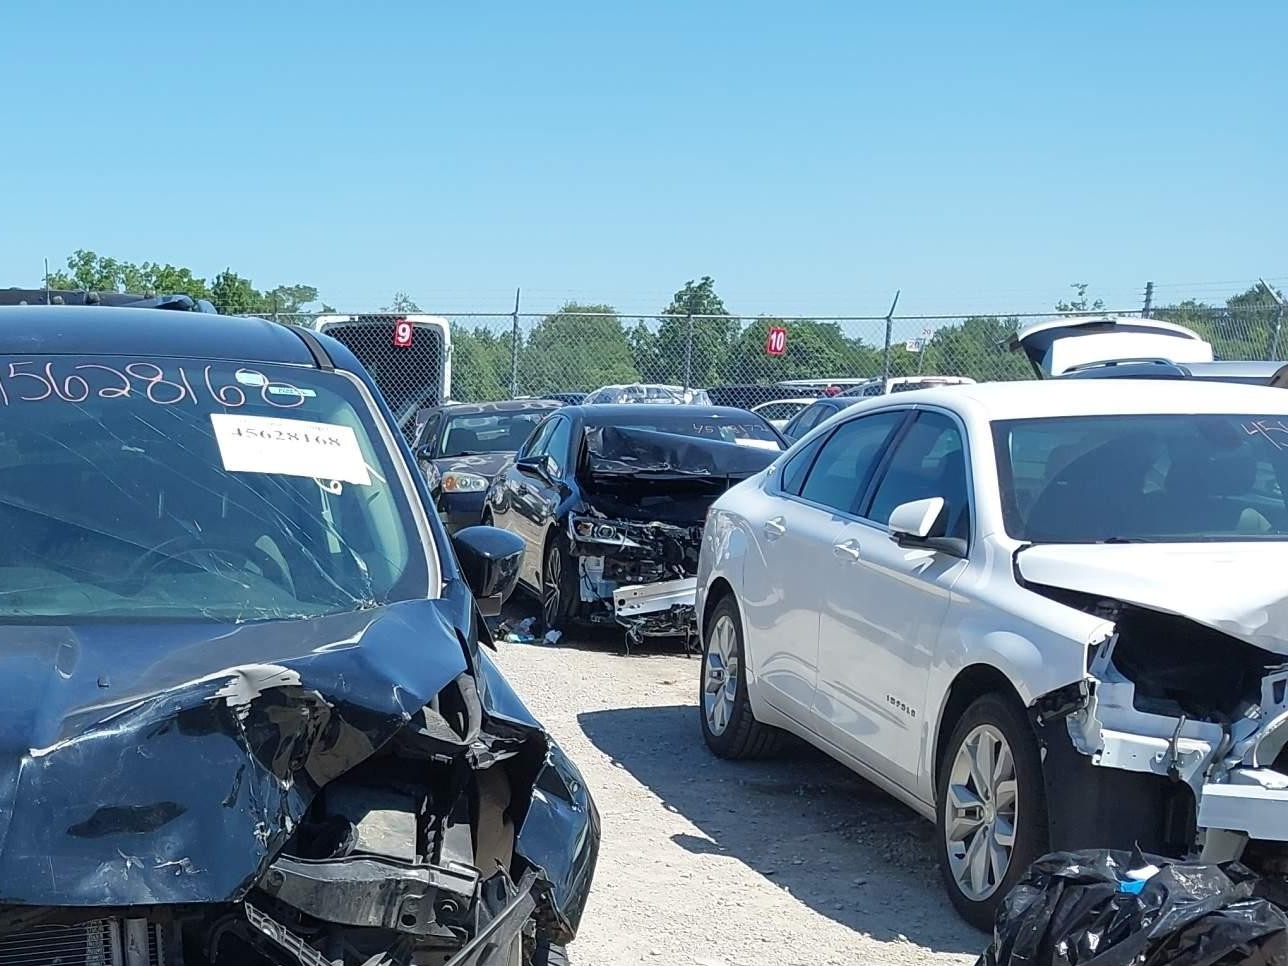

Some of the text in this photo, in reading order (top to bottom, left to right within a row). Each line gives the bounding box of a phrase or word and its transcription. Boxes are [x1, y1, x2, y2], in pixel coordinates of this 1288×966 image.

[397, 323, 411, 343] 9
[770, 331, 785, 351] 10
[232, 427, 342, 447] 45628168
